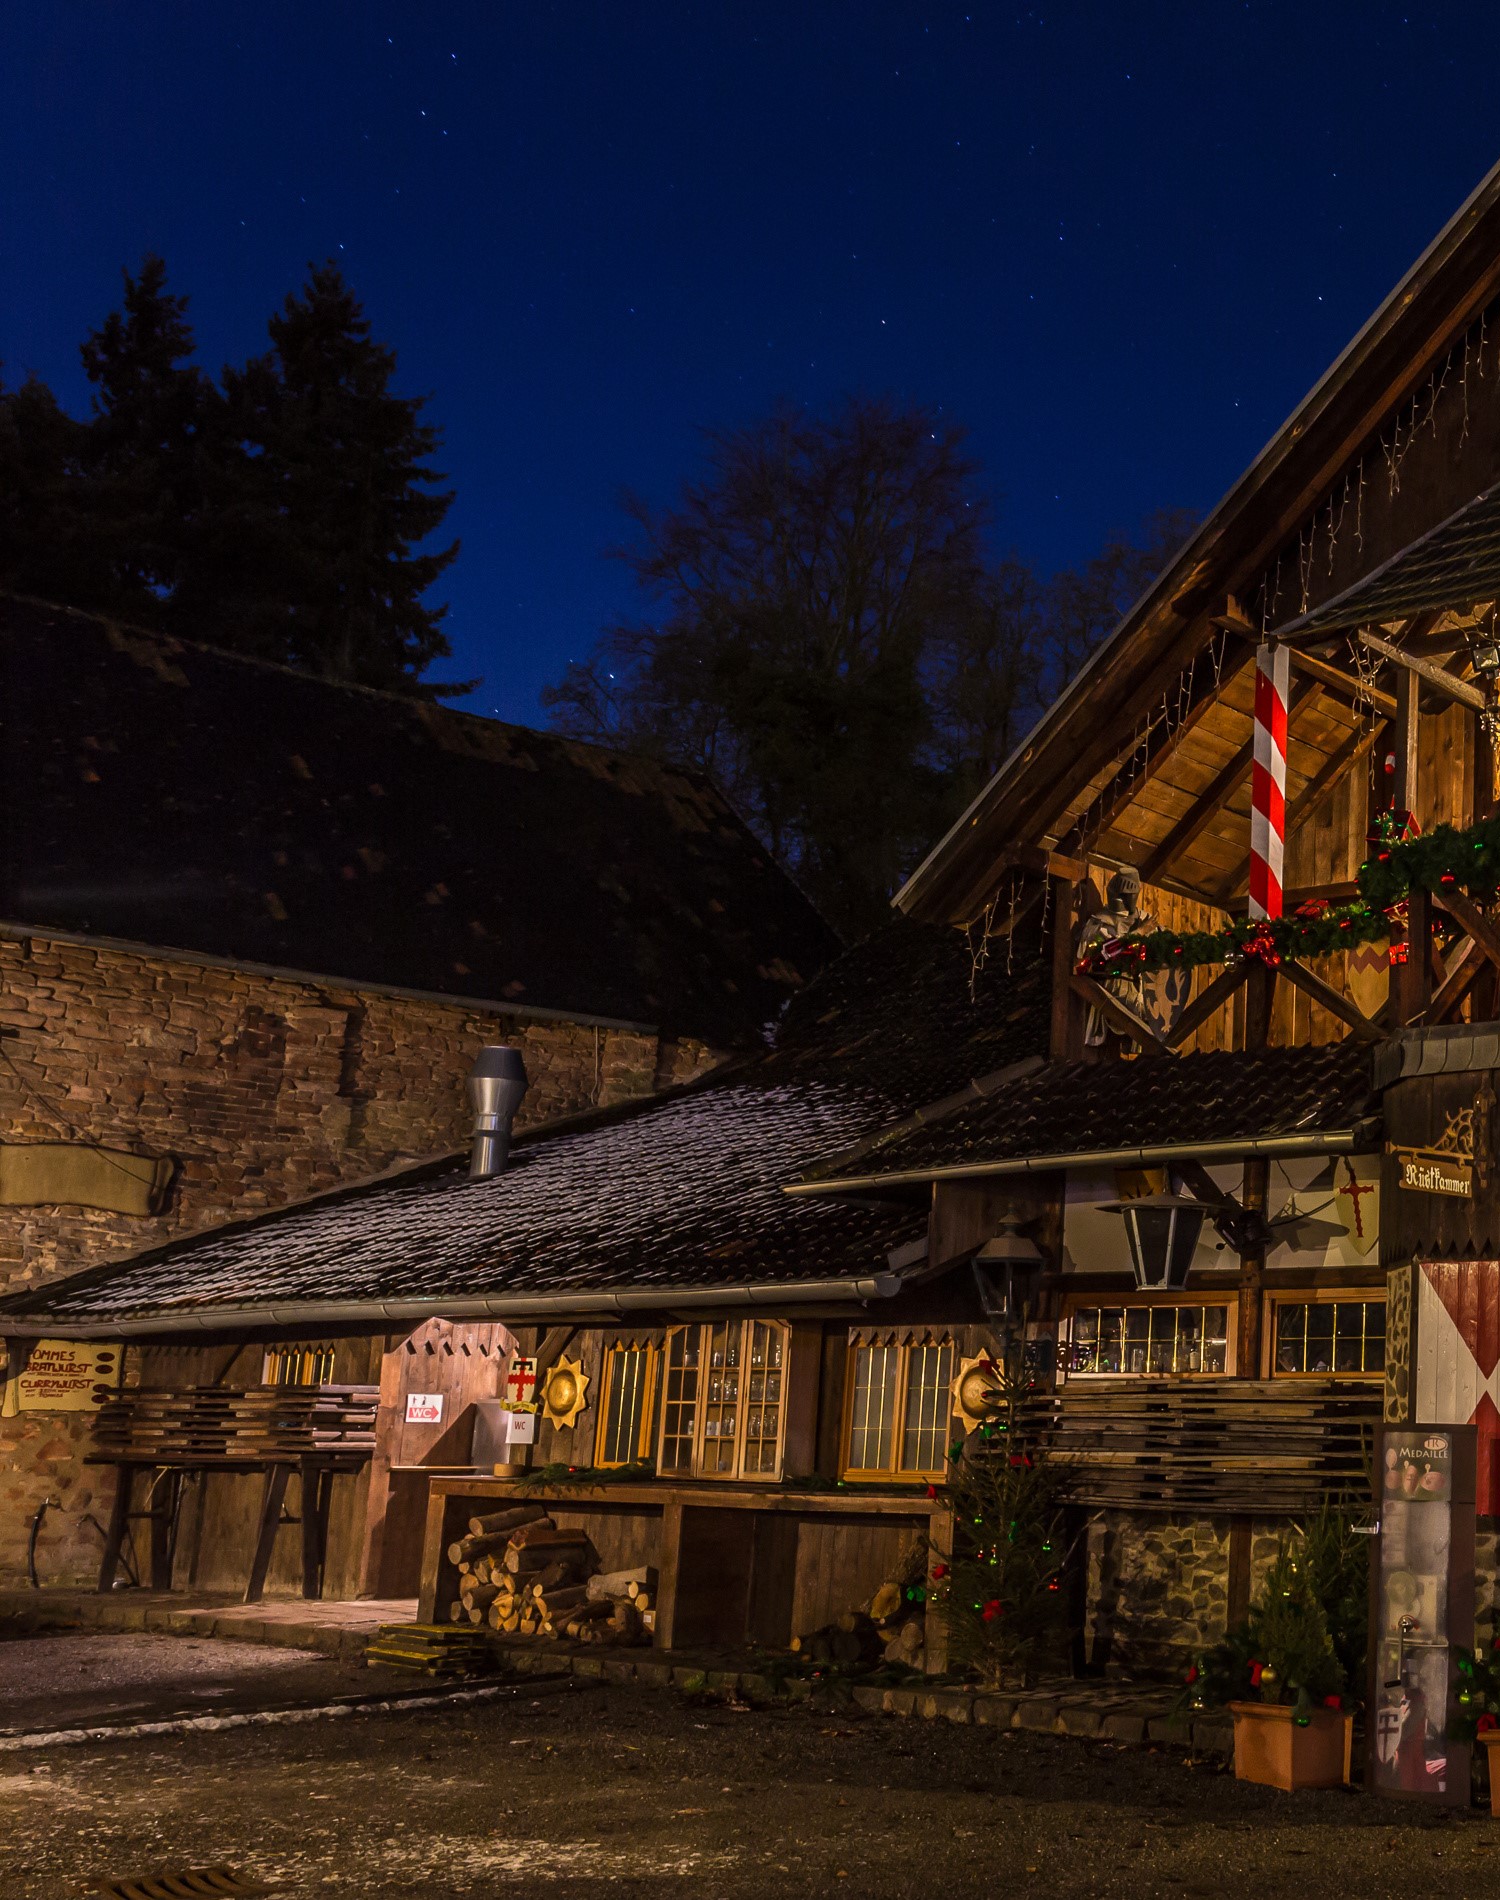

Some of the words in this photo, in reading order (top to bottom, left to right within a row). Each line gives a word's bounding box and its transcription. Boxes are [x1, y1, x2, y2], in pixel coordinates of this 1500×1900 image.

[1405, 1164, 1470, 1194] Rüstkammer
[32, 1349, 76, 1361] OMMES
[20, 1379, 95, 1389] CURRYWURST
[411, 1408, 432, 1418] WC
[514, 1421, 526, 1430] WC
[1399, 1447, 1449, 1459] MEDAILLE
